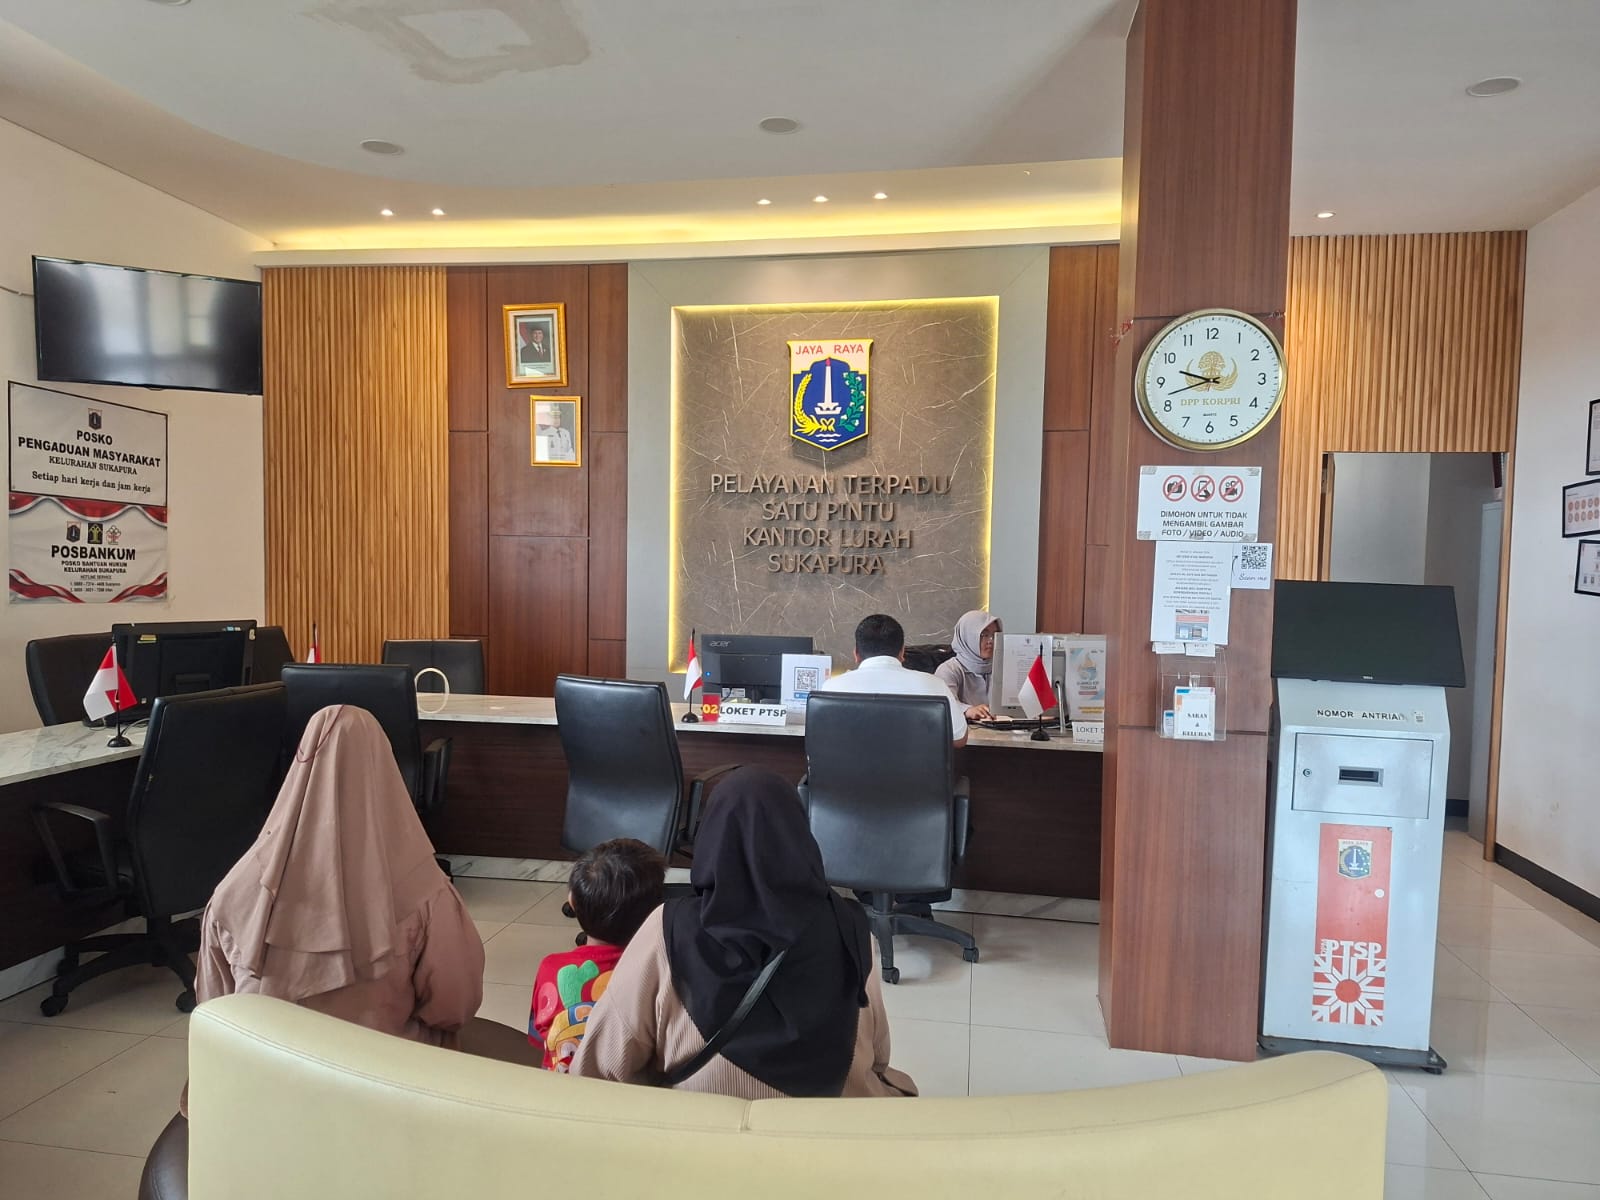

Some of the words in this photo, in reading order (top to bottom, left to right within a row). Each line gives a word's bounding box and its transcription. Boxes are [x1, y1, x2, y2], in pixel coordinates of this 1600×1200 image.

[1183, 334, 1193, 346] 11
[1206, 328, 1219, 340] 12
[795, 344, 823, 355] JAYA
[834, 343, 864, 354] RAYA
[1250, 349, 1260, 361] 2
[1164, 352, 1176, 364] 10
[1157, 377, 1165, 388] 9
[1257, 373, 1266, 385] 3
[1163, 400, 1172, 412] 8
[1180, 398, 1200, 407] DPP
[1202, 397, 1241, 406] KORPRI
[1249, 397, 1258, 408] 4
[1181, 416, 1190, 428] 7
[1229, 415, 1238, 427] 5
[1205, 421, 1214, 434] 6
[76, 430, 113, 446] POSKO
[18, 436, 90, 458] PENGADUAN
[93, 447, 161, 468] MASYARAKAT
[49, 456, 97, 470] KELURAHAN
[99, 462, 138, 475] SUKAPURA
[32, 471, 59, 484] Setiap
[61, 474, 78, 485] hari
[80, 476, 100, 488] kerja
[102, 478, 116, 489] dan
[117, 480, 131, 492] jam
[133, 482, 151, 494] kerja
[711, 473, 835, 494] PELAYANAN
[844, 475, 950, 495] TERPADU
[762, 502, 818, 522] SATU
[826, 502, 895, 522] PINTU
[1160, 510, 1196, 519] DIMOHON
[1197, 510, 1224, 519] UNTUK
[1225, 511, 1248, 519] TIDAK
[1162, 520, 1208, 528] MENGAMBIL
[1209, 520, 1244, 529] GAMBAR
[743, 528, 831, 547] KANTOR
[840, 529, 913, 549] LURAH
[1161, 529, 1181, 538] FOTO
[1189, 529, 1213, 538] VIDEO
[1220, 529, 1245, 539] AUDIO
[51, 545, 136, 561] POSBANKUM
[767, 553, 886, 575] SUKAPURA
[709, 640, 732, 648] acer
[702, 704, 719, 714] 02
[720, 706, 756, 717] LOKET
[759, 707, 787, 718] PTSP
[1317, 710, 1354, 718] NOMOR
[1076, 726, 1098, 734] LOKET
[1325, 939, 1382, 959] PTSP
